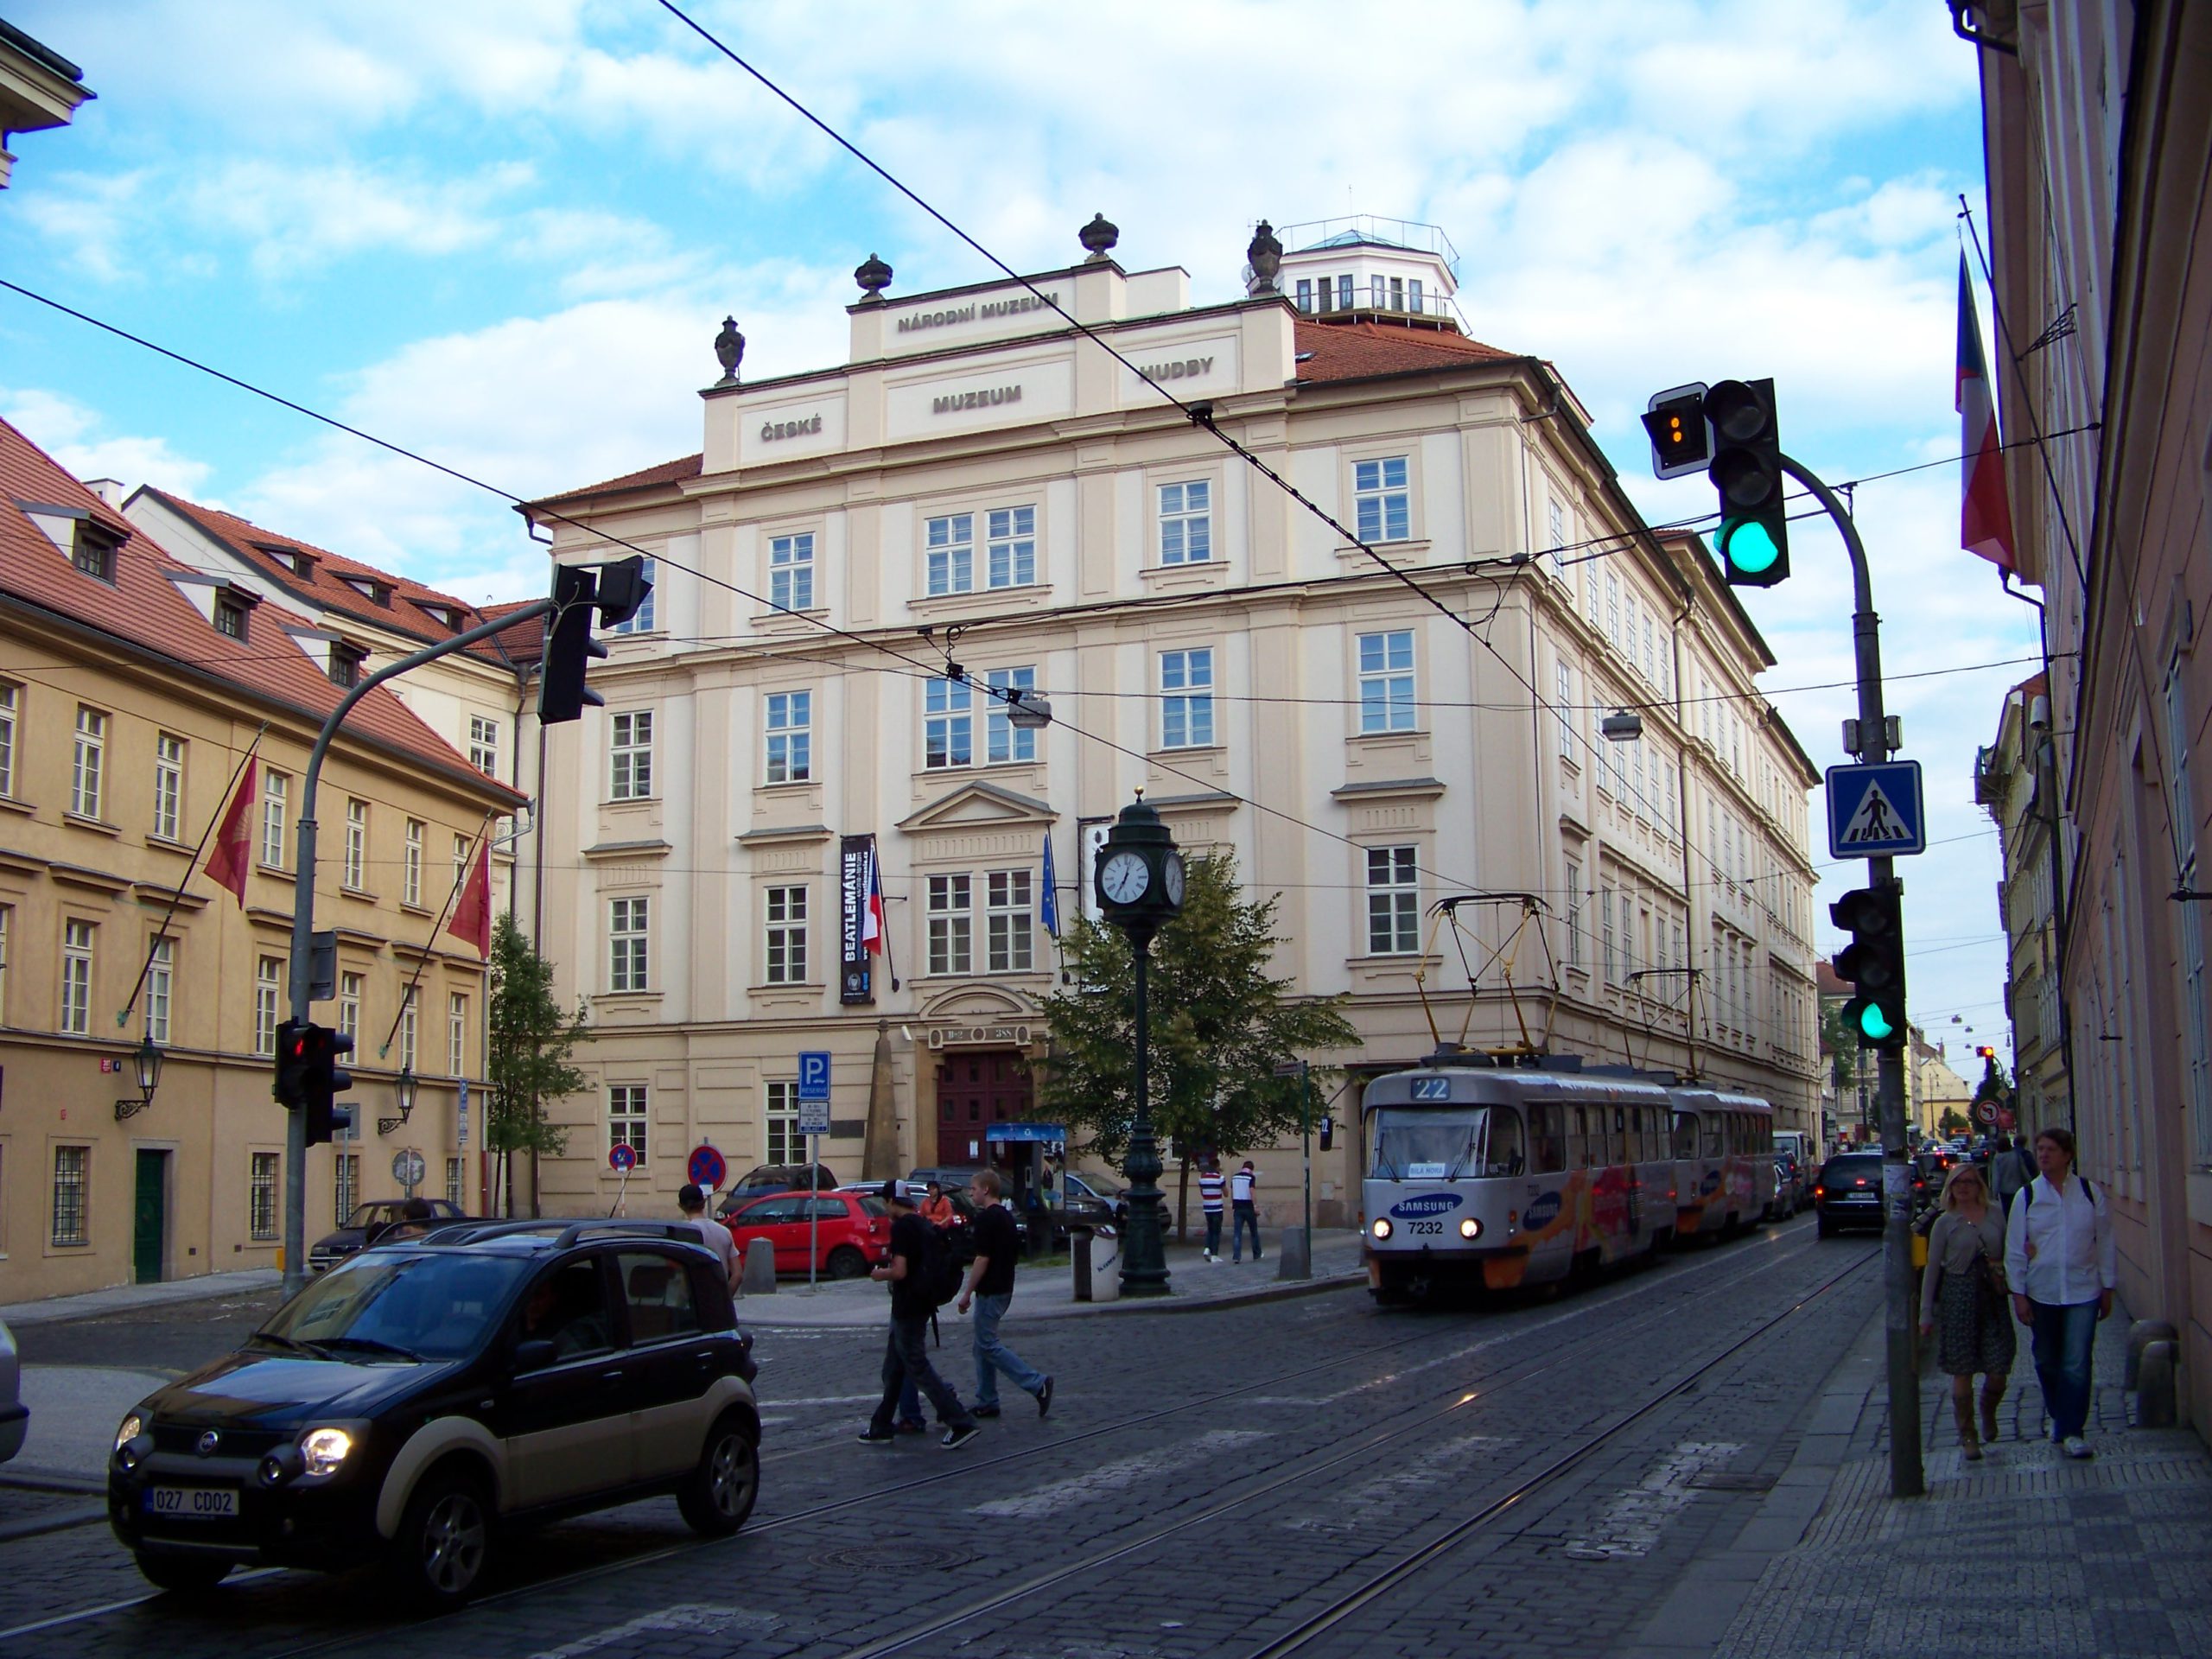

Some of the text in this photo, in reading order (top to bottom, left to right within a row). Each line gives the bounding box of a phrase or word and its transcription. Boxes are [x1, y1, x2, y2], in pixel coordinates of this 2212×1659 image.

[898, 292, 1058, 333] NÁRODNÍ MUZEUM
[760, 356, 1214, 442] ČESKÉ MUZEUM HUDBY
[842, 852, 856, 962] BEATLEMÁNIE
[806, 1058, 823, 1084] P
[1415, 1078, 1447, 1099] 22
[1398, 1201, 1454, 1212] SAMSUNG
[1407, 1221, 1443, 1235] 7232
[156, 1490, 232, 1512] 027 CD02
